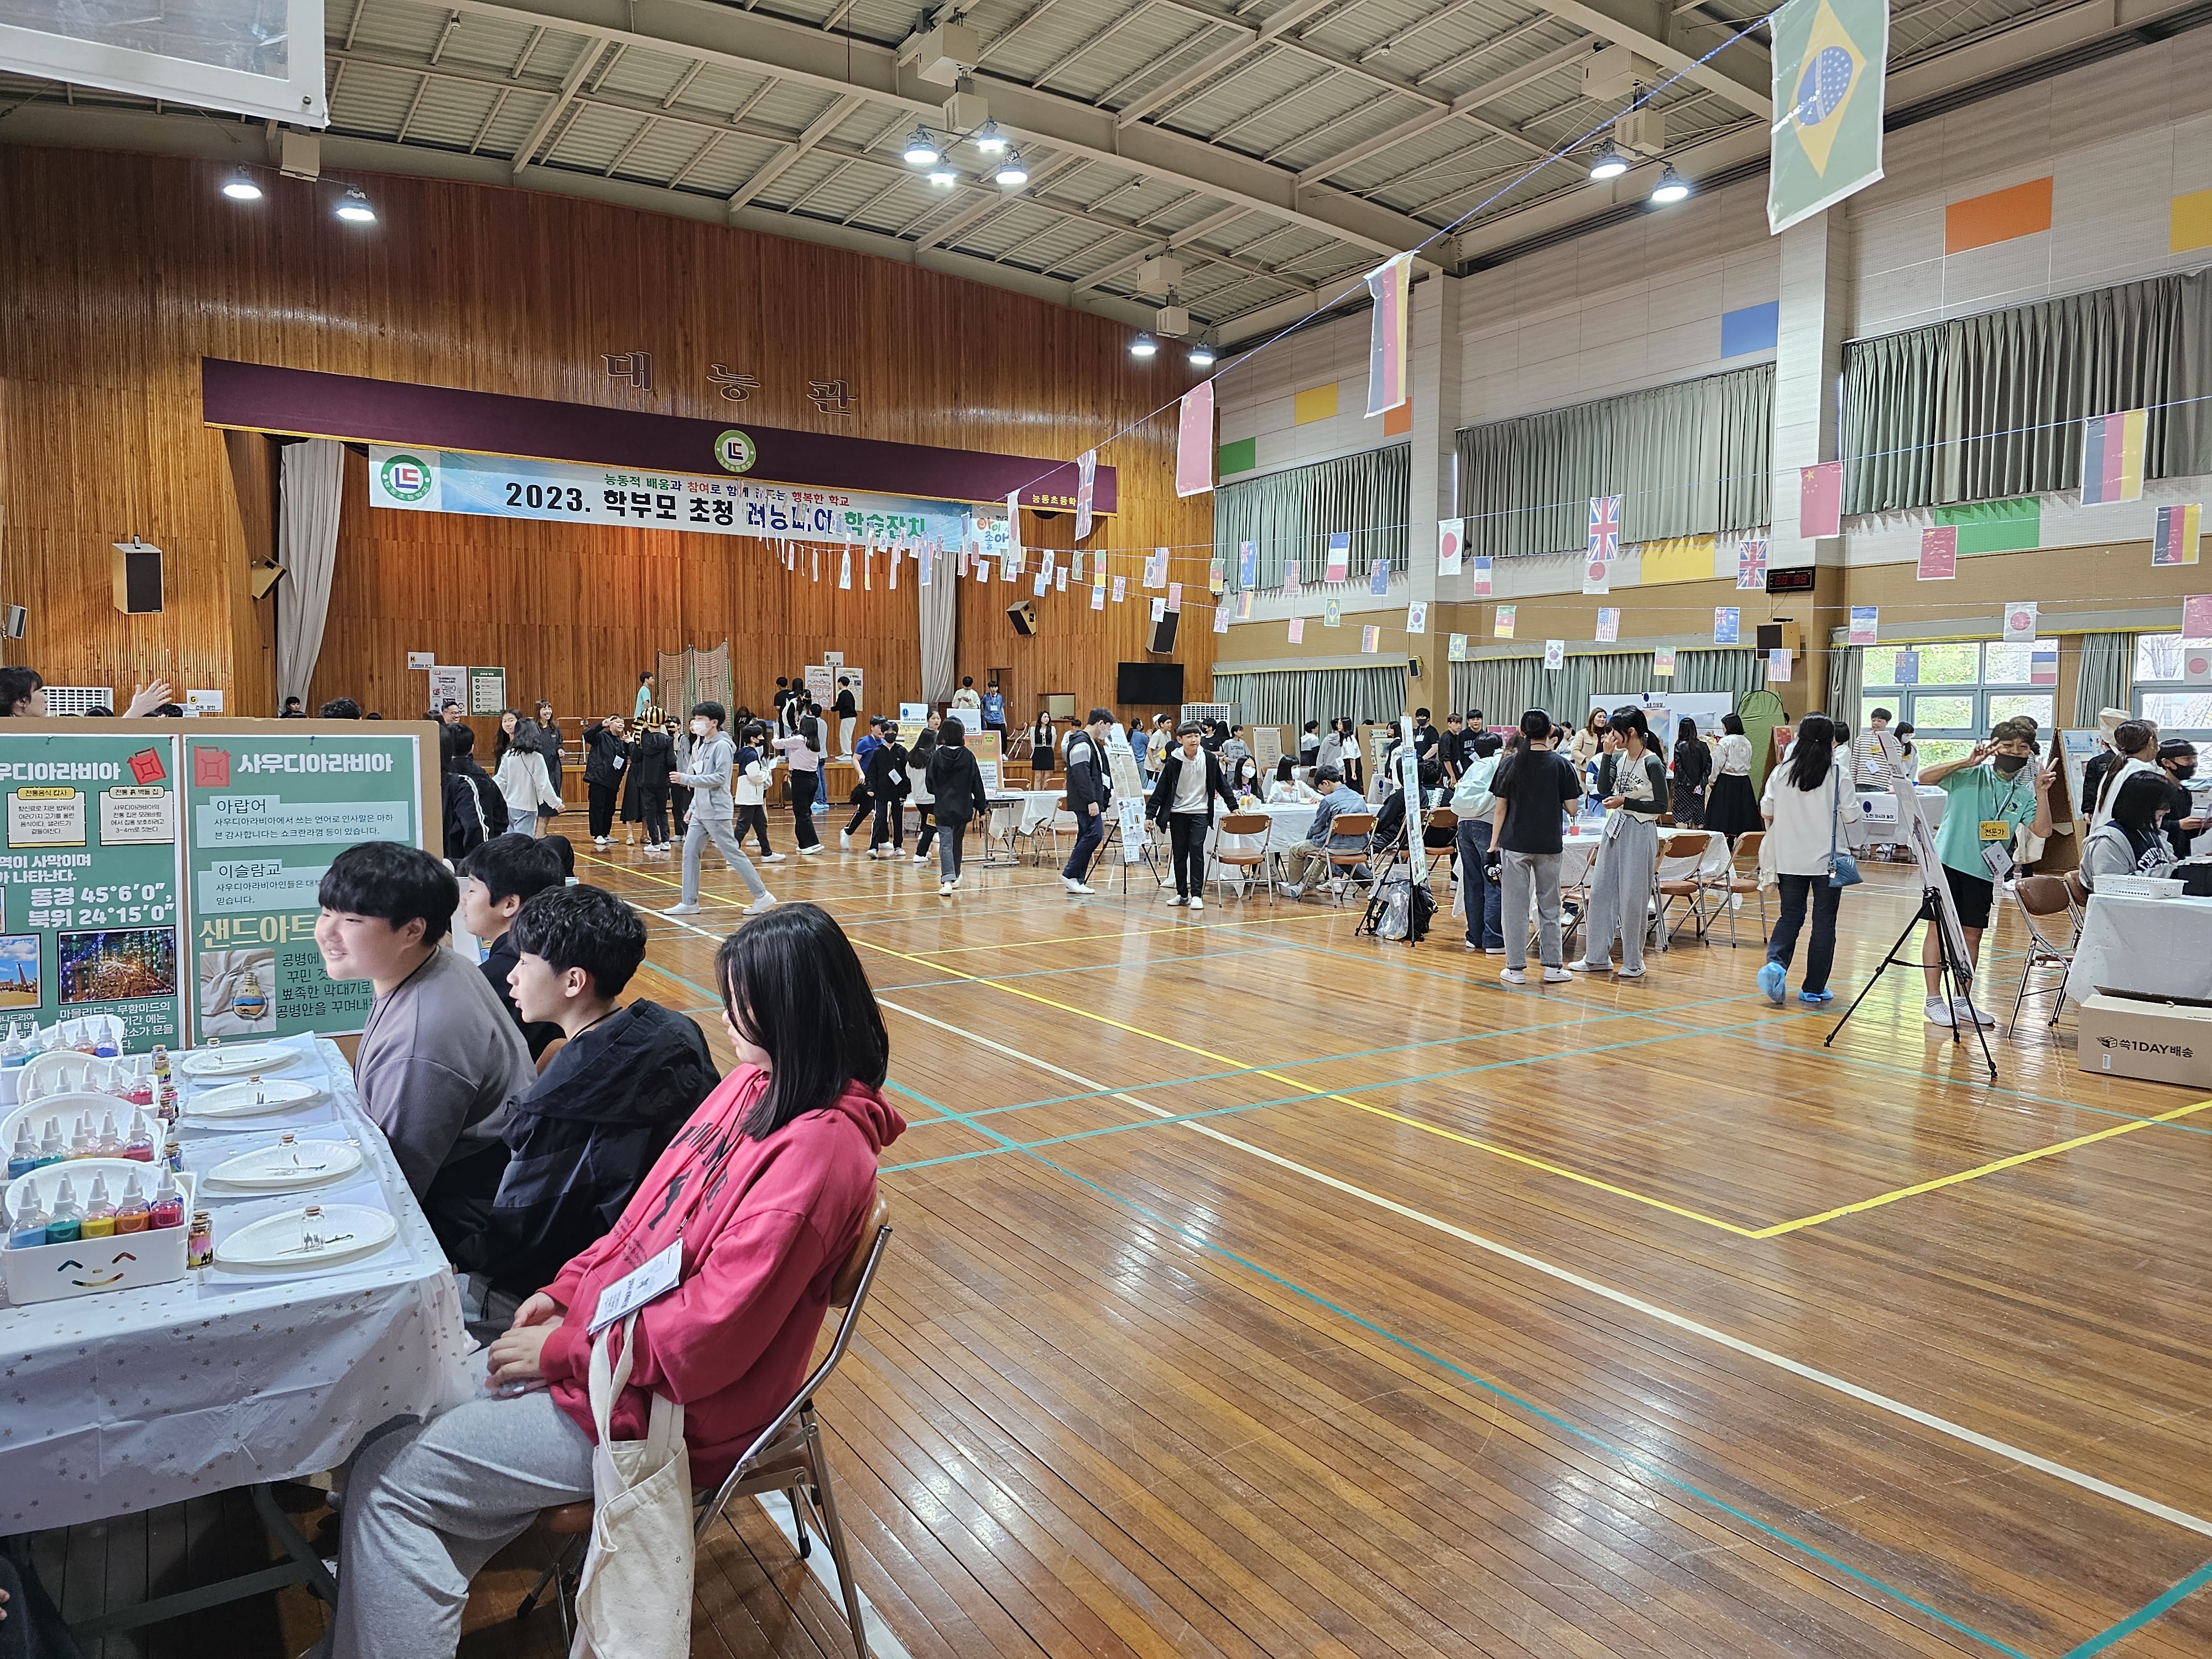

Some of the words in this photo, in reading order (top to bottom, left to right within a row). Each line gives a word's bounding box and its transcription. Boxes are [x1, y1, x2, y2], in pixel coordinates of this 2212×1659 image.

[604, 474, 640, 488] 능동적
[646, 478, 682, 492] 배움과
[687, 481, 721, 495] 참여로
[792, 491, 824, 505] 행복한
[828, 494, 849, 507] 학교
[1032, 494, 1077, 506] 능동초등학
[505, 482, 591, 513] 2023.
[603, 489, 677, 520] 학부모
[690, 497, 733, 526] 초청
[844, 511, 926, 539] 학습잔치
[237, 753, 394, 774] 사우디아라비아
[216, 799, 266, 815] 아랍어
[214, 816, 294, 826] 사우디아라비아에서
[296, 816, 313, 825] 쓰는
[315, 815, 341, 825] 언어로
[342, 814, 375, 823] 인사말은
[377, 813, 394, 822] 마하
[226, 830, 278, 839] 감사합니다는
[345, 827, 380, 836] 있습니다.
[1984, 828, 2005, 837] 전문가
[32, 853, 91, 867] 사막이며
[13, 869, 77, 883] 나타난다.
[219, 863, 281, 878] 이슬람교
[216, 880, 304, 891] 사우디아라비아인들은
[30, 886, 75, 907] 동경
[216, 896, 255, 906] 믿습니다.
[28, 907, 73, 928] 북위
[199, 914, 315, 948] 샌드아트
[282, 952, 319, 967] 공병에
[287, 969, 311, 983] 꾸민
[282, 985, 320, 1000] 뾰족한
[324, 981, 373, 997] 막대기로
[117, 1001, 170, 1014] 무함마드의
[276, 1001, 326, 1018] 공병안을
[145, 1014, 167, 1024] 에는
[152, 1024, 174, 1036] 문을
